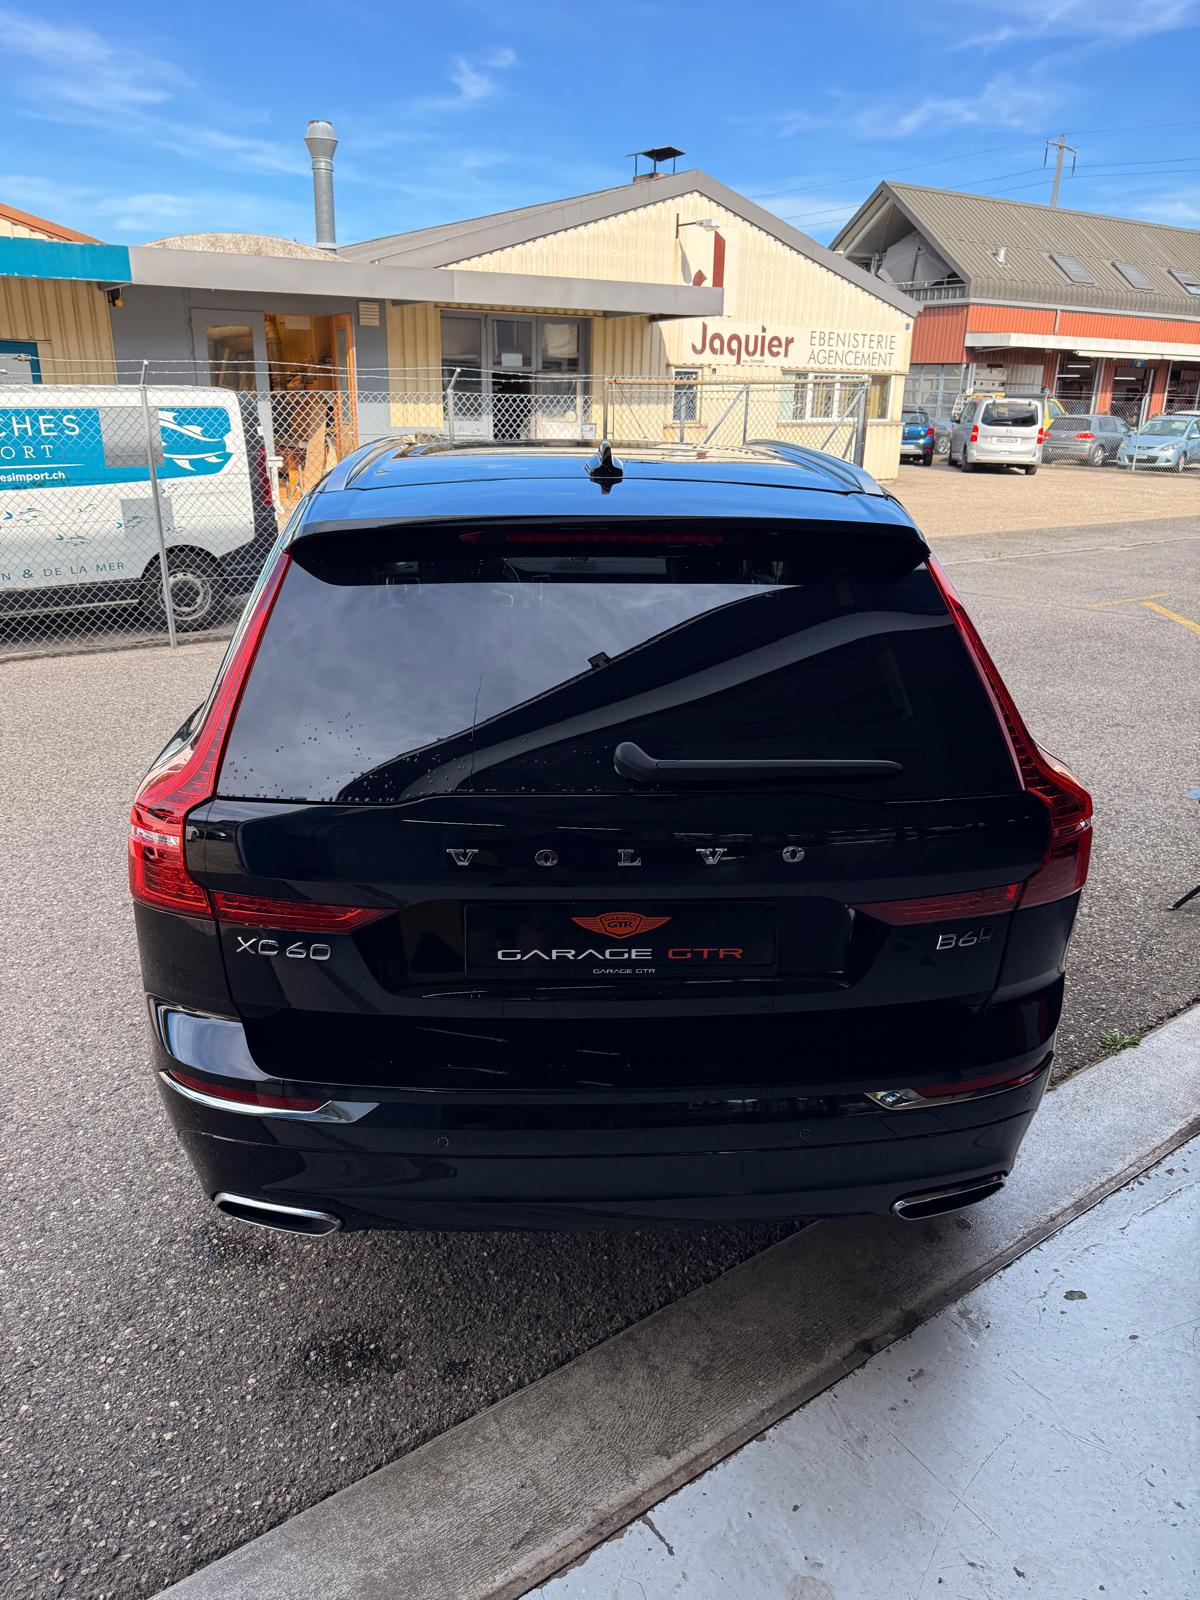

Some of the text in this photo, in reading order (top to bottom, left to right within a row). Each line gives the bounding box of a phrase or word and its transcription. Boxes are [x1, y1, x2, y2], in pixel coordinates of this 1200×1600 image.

[692, 321, 794, 365] Jaquier
[809, 331, 896, 350] EBENISTERIE
[807, 349, 894, 367] AGENCEMENT
[22, 568, 34, 578] &
[43, 568, 62, 577] DE
[70, 565, 88, 575] LA
[96, 561, 125, 573] MER
[446, 846, 805, 867] VOLVO
[607, 921, 633, 929] GTR
[497, 948, 744, 960] GARAGE GTR
